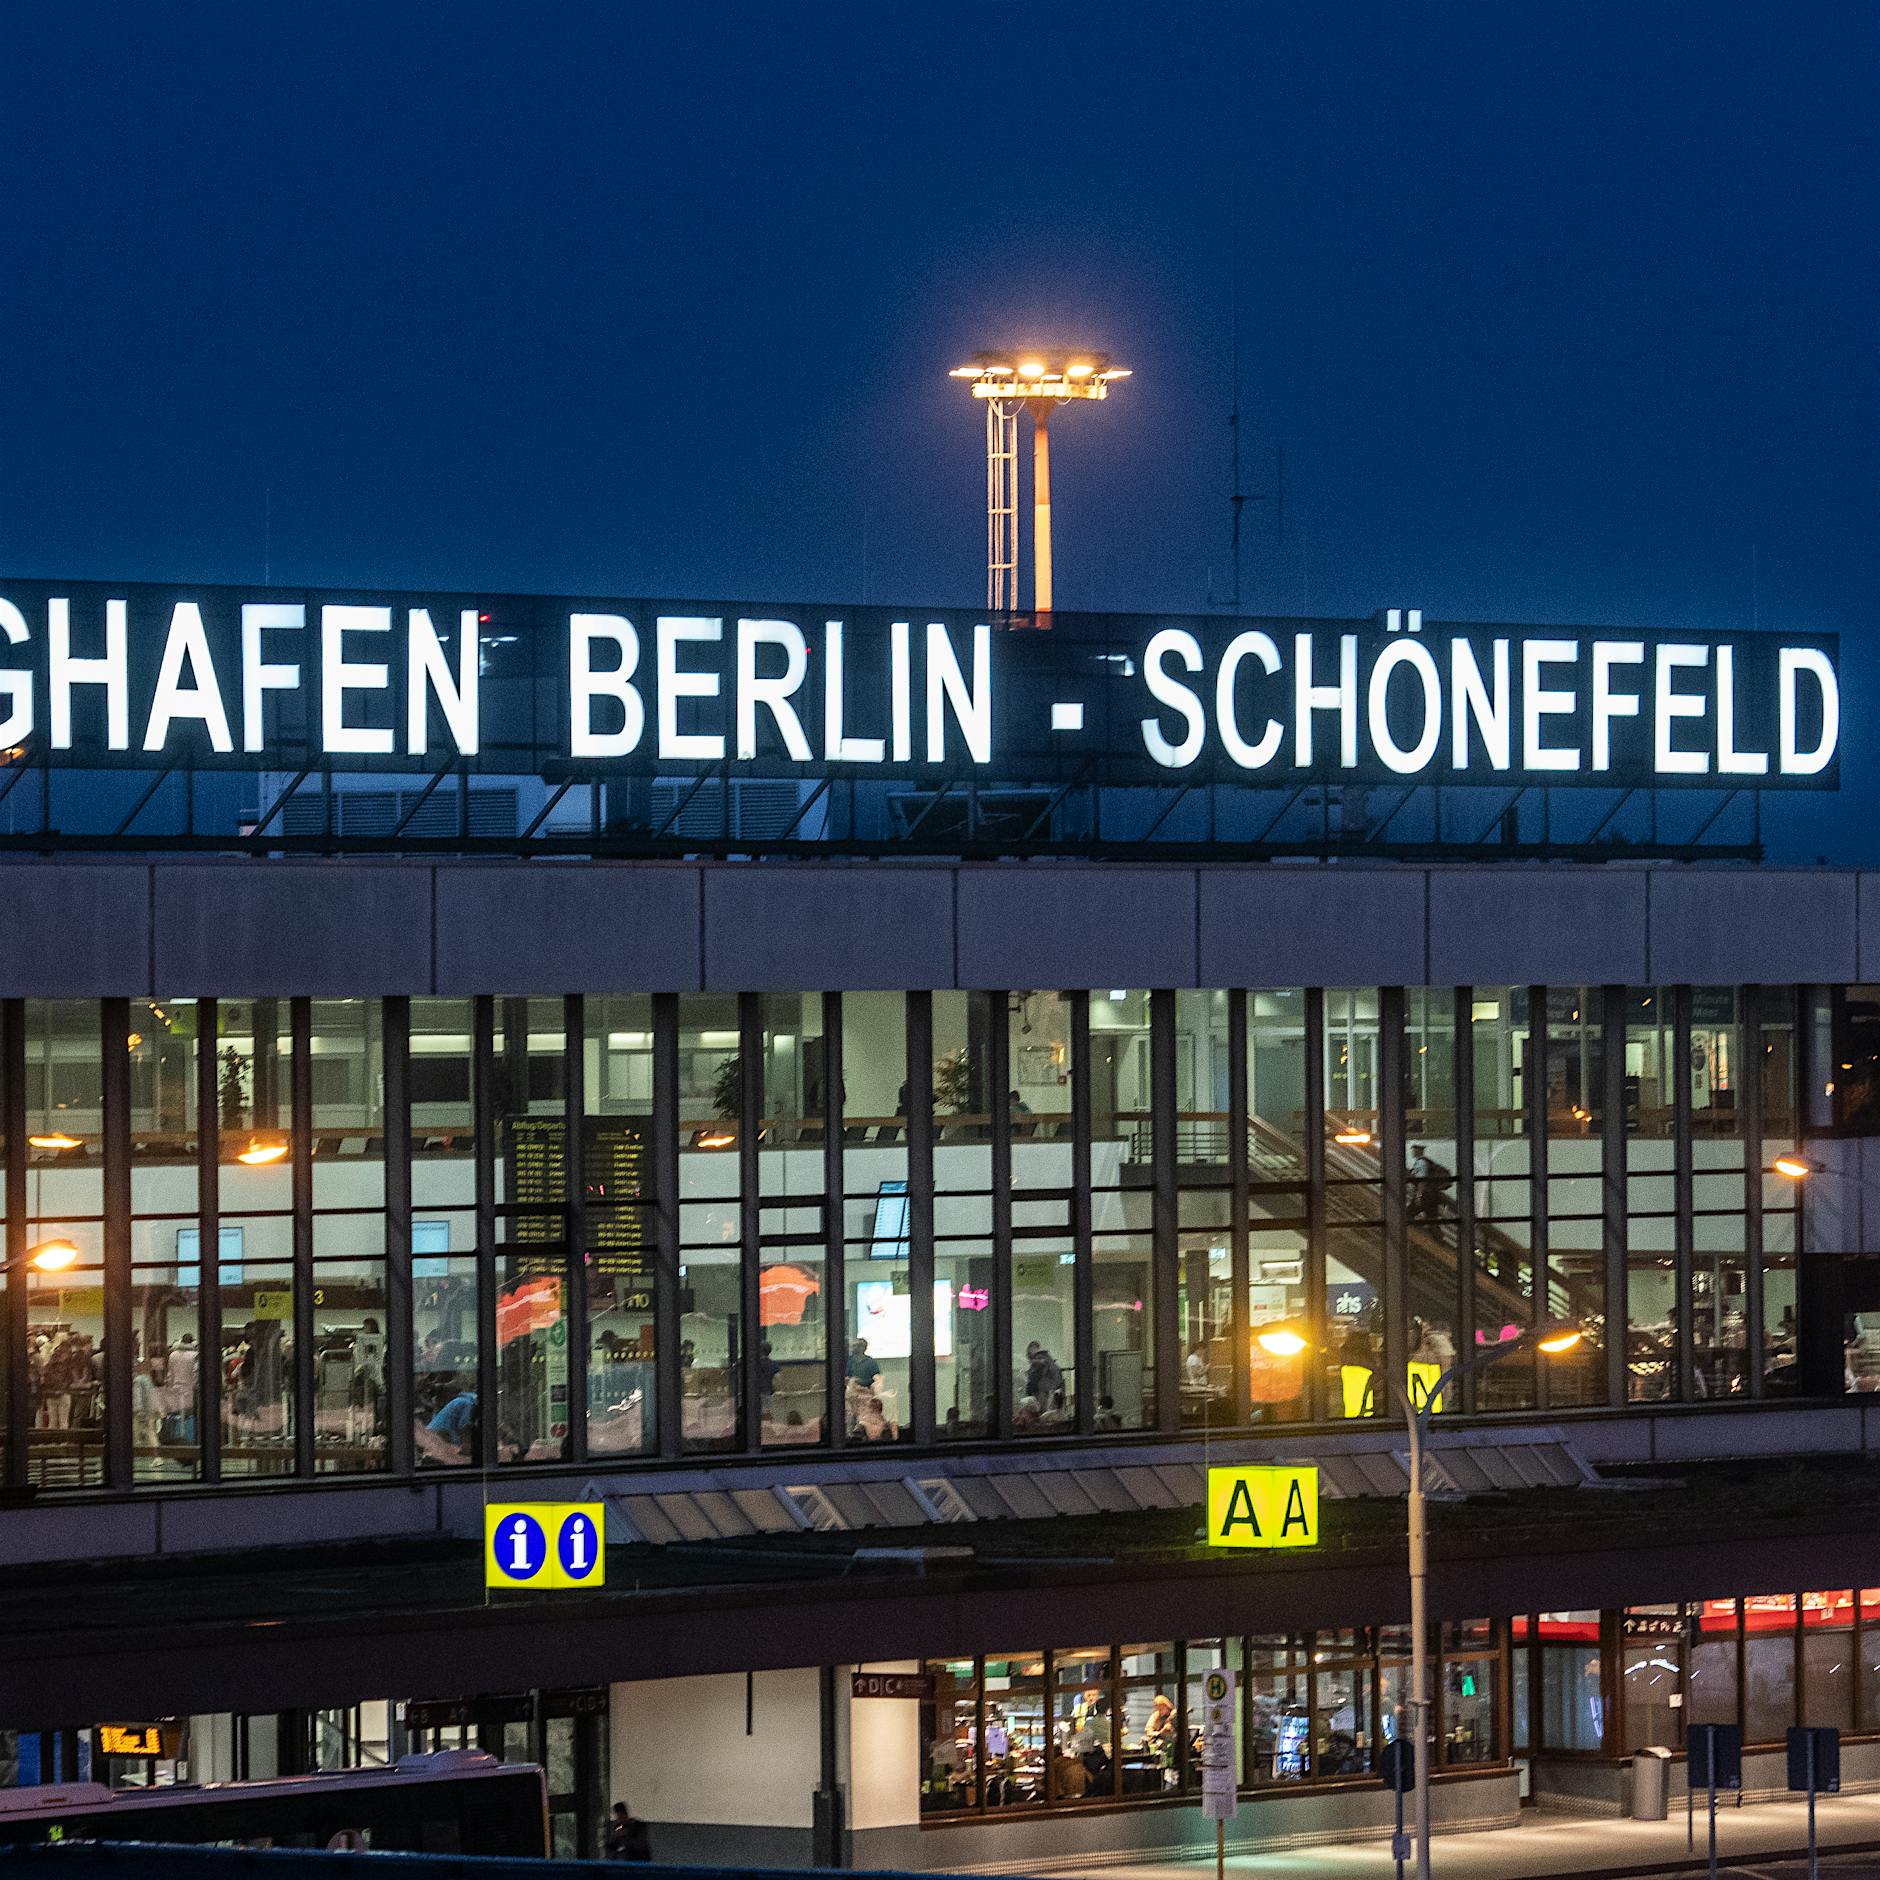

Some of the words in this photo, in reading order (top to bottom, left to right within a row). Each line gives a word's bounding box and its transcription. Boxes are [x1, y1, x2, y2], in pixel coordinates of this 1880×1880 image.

[569, 613, 992, 764] BERLIN
[1140, 608, 1840, 775] SCHÖNEFELD
[314, 1290, 325, 1305] 3
[1220, 1479, 1262, 1537] A
[1281, 1479, 1309, 1537] A
